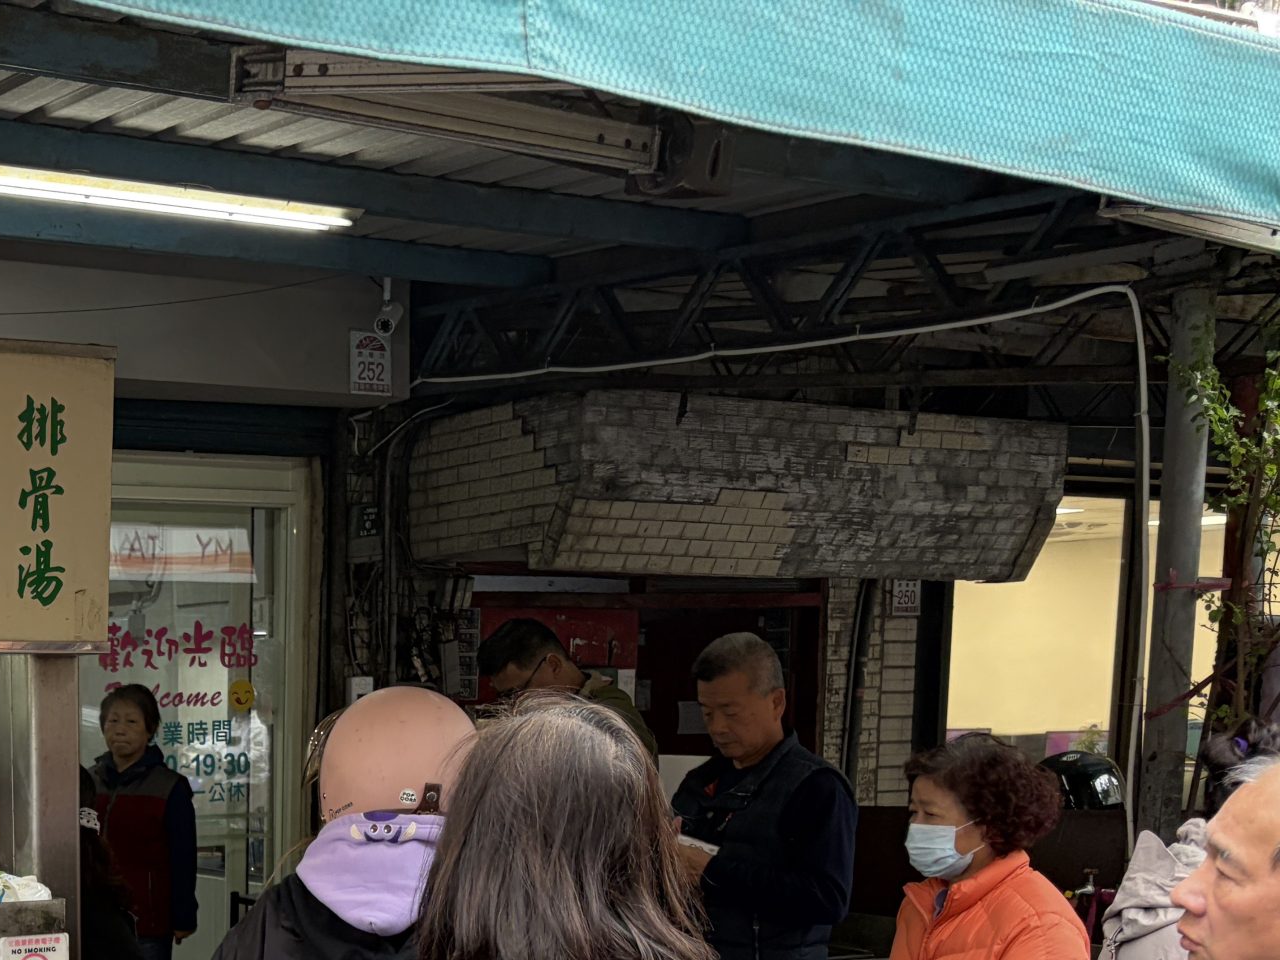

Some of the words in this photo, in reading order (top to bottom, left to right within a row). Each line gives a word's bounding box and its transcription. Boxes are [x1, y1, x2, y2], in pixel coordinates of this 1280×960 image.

[357, 361, 385, 382] 252
[17, 394, 68, 607] 排骨湯
[897, 590, 916, 605] 250
[156, 719, 232, 747] 業時間
[24, 946, 57, 954] SMOKING
